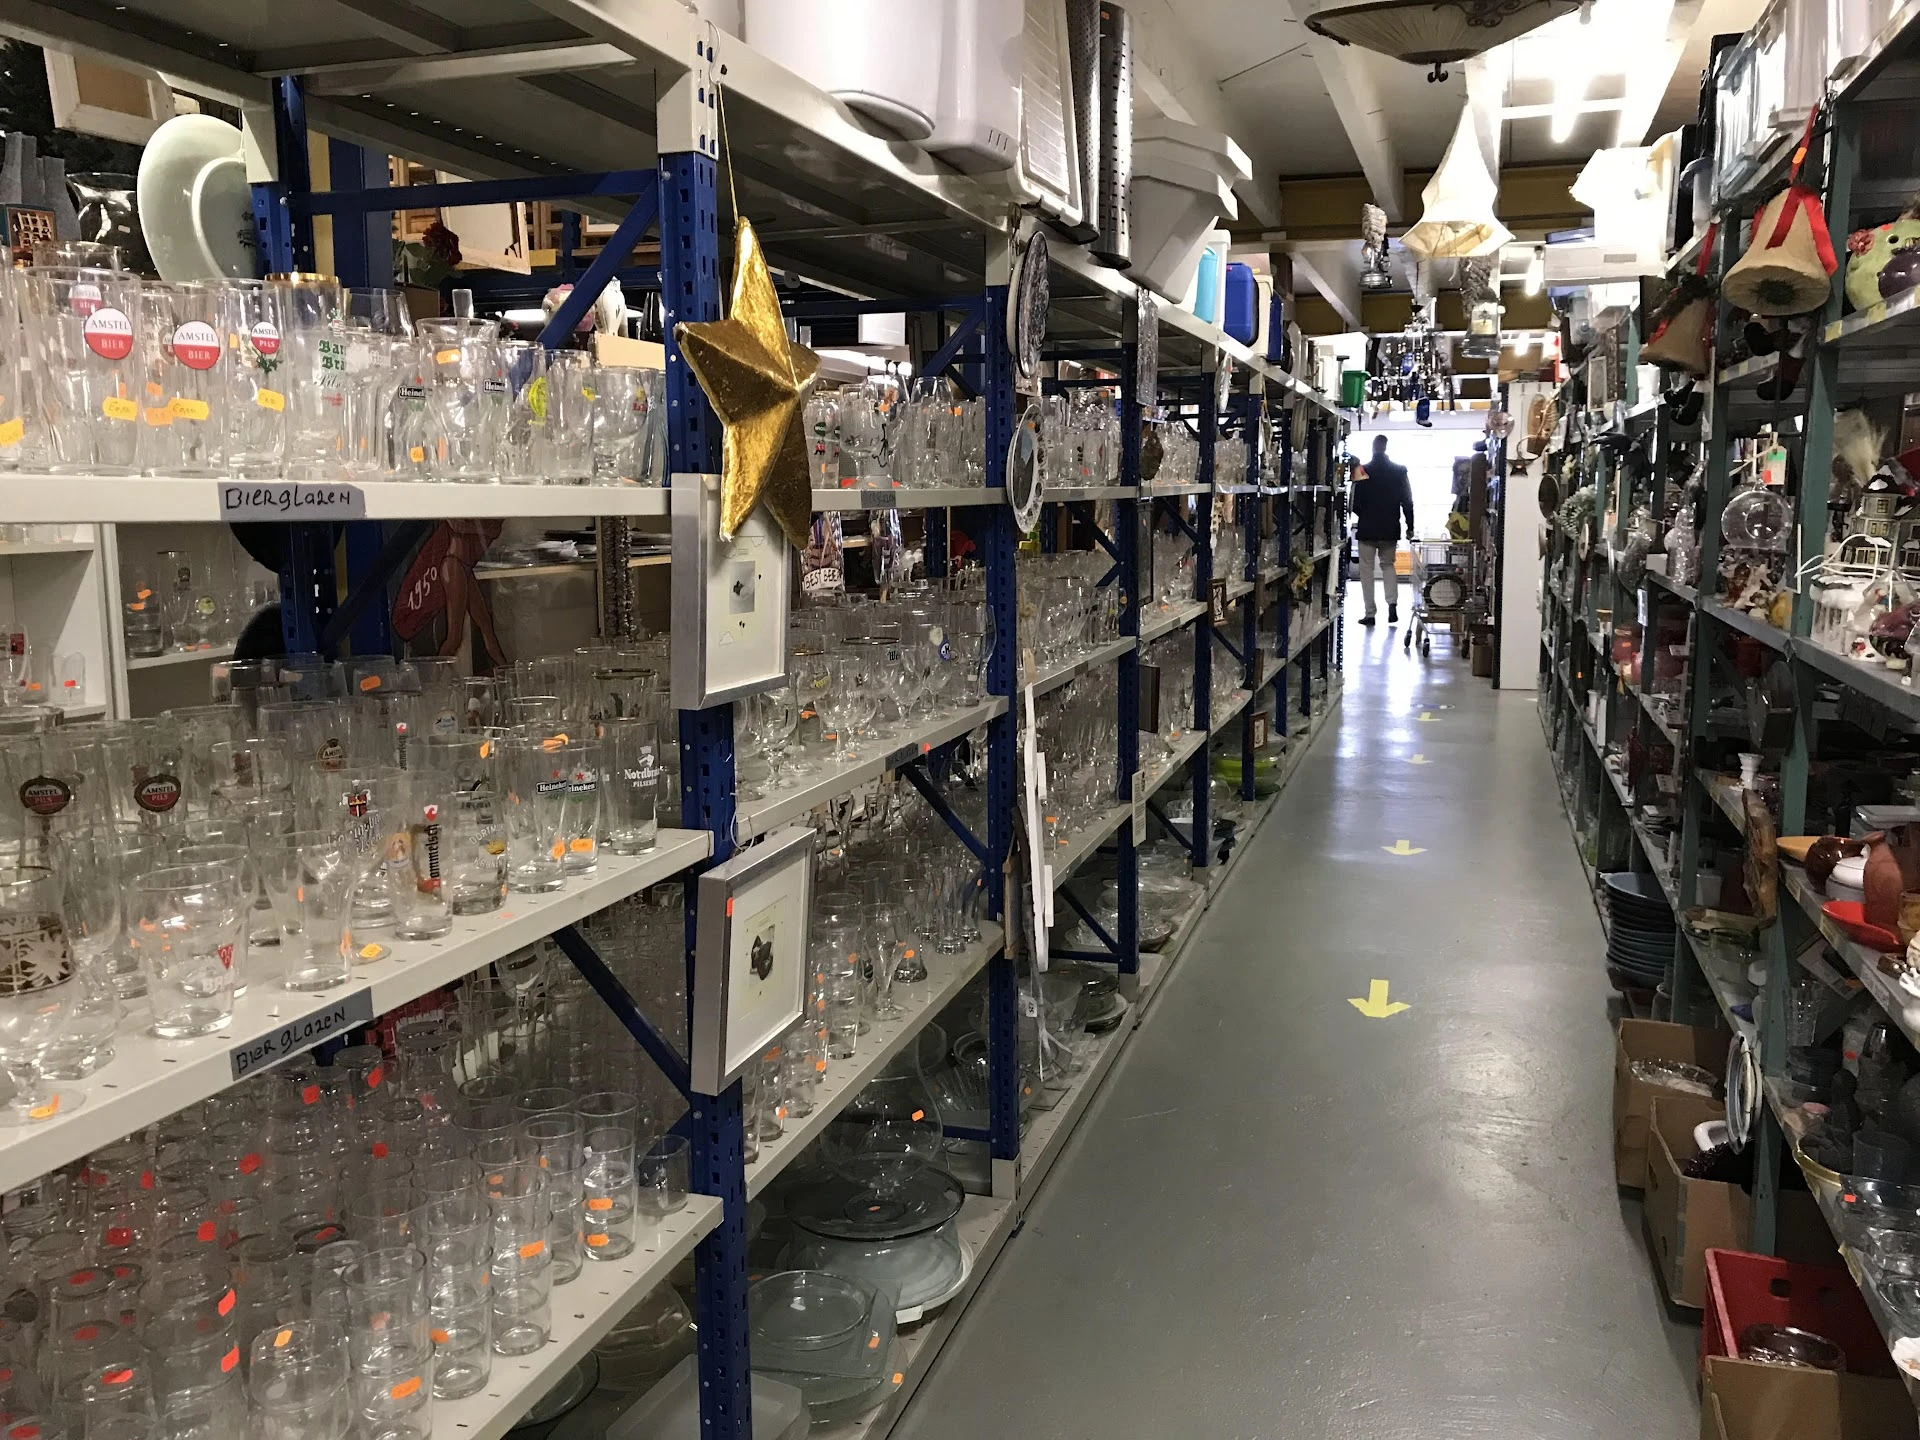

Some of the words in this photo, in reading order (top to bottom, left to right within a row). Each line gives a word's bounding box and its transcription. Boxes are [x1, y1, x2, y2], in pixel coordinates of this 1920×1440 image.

[91, 319, 129, 330] AMSTEL
[179, 331, 215, 342] AMSTEL
[253, 328, 278, 336] AMSTEL
[101, 339, 125, 350] BIER
[259, 340, 276, 348] PILS
[188, 350, 211, 360] BIER
[407, 566, 438, 611] 1950
[28, 788, 58, 796] AMSTEL
[146, 785, 174, 793] AMSTEL
